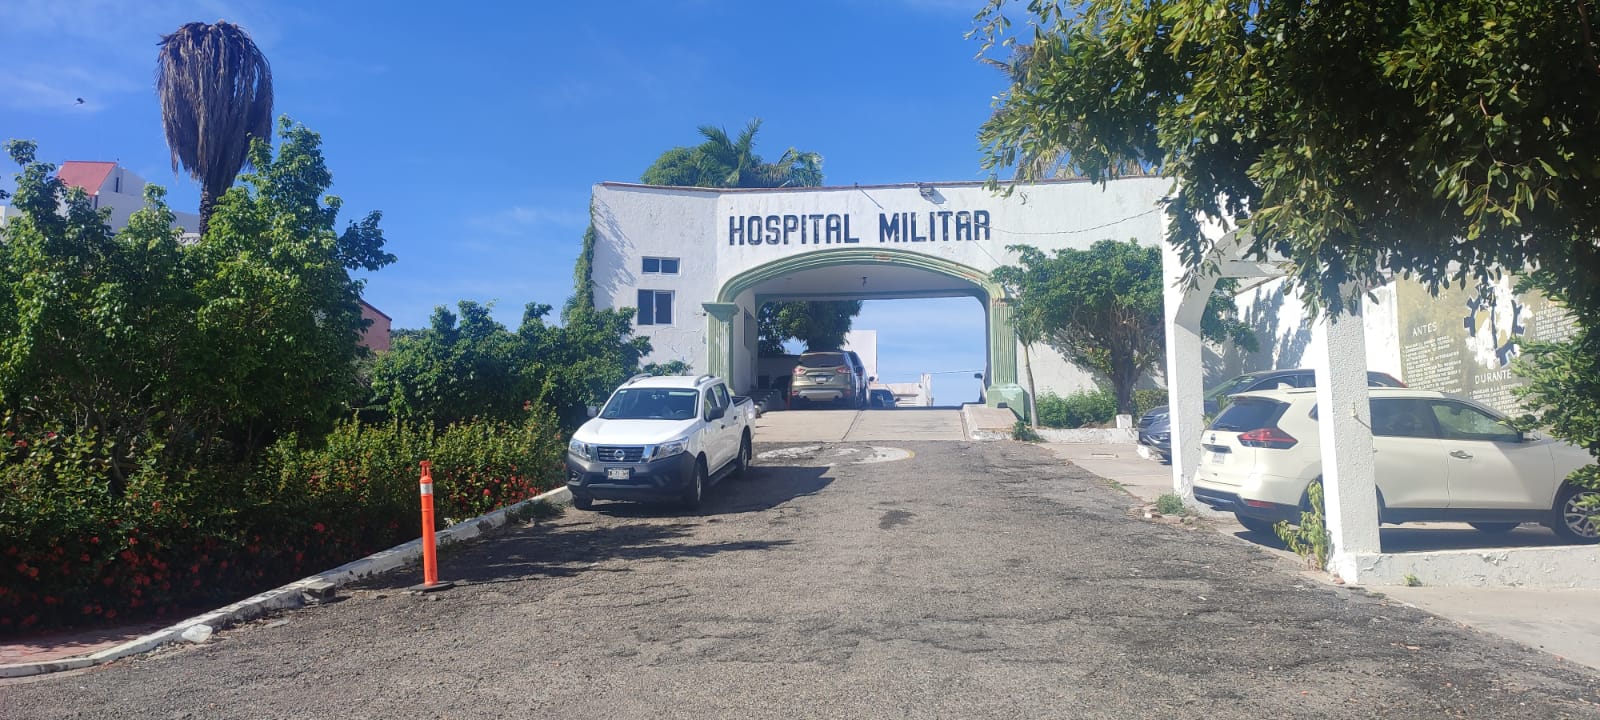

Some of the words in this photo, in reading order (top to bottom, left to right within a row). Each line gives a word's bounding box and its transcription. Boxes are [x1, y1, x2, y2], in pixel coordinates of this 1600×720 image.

[729, 213, 860, 246] HOSPITAL
[879, 210, 991, 243] MILITAR
[1412, 321, 1438, 337] ANTES
[1474, 369, 1512, 385] DURANTE
